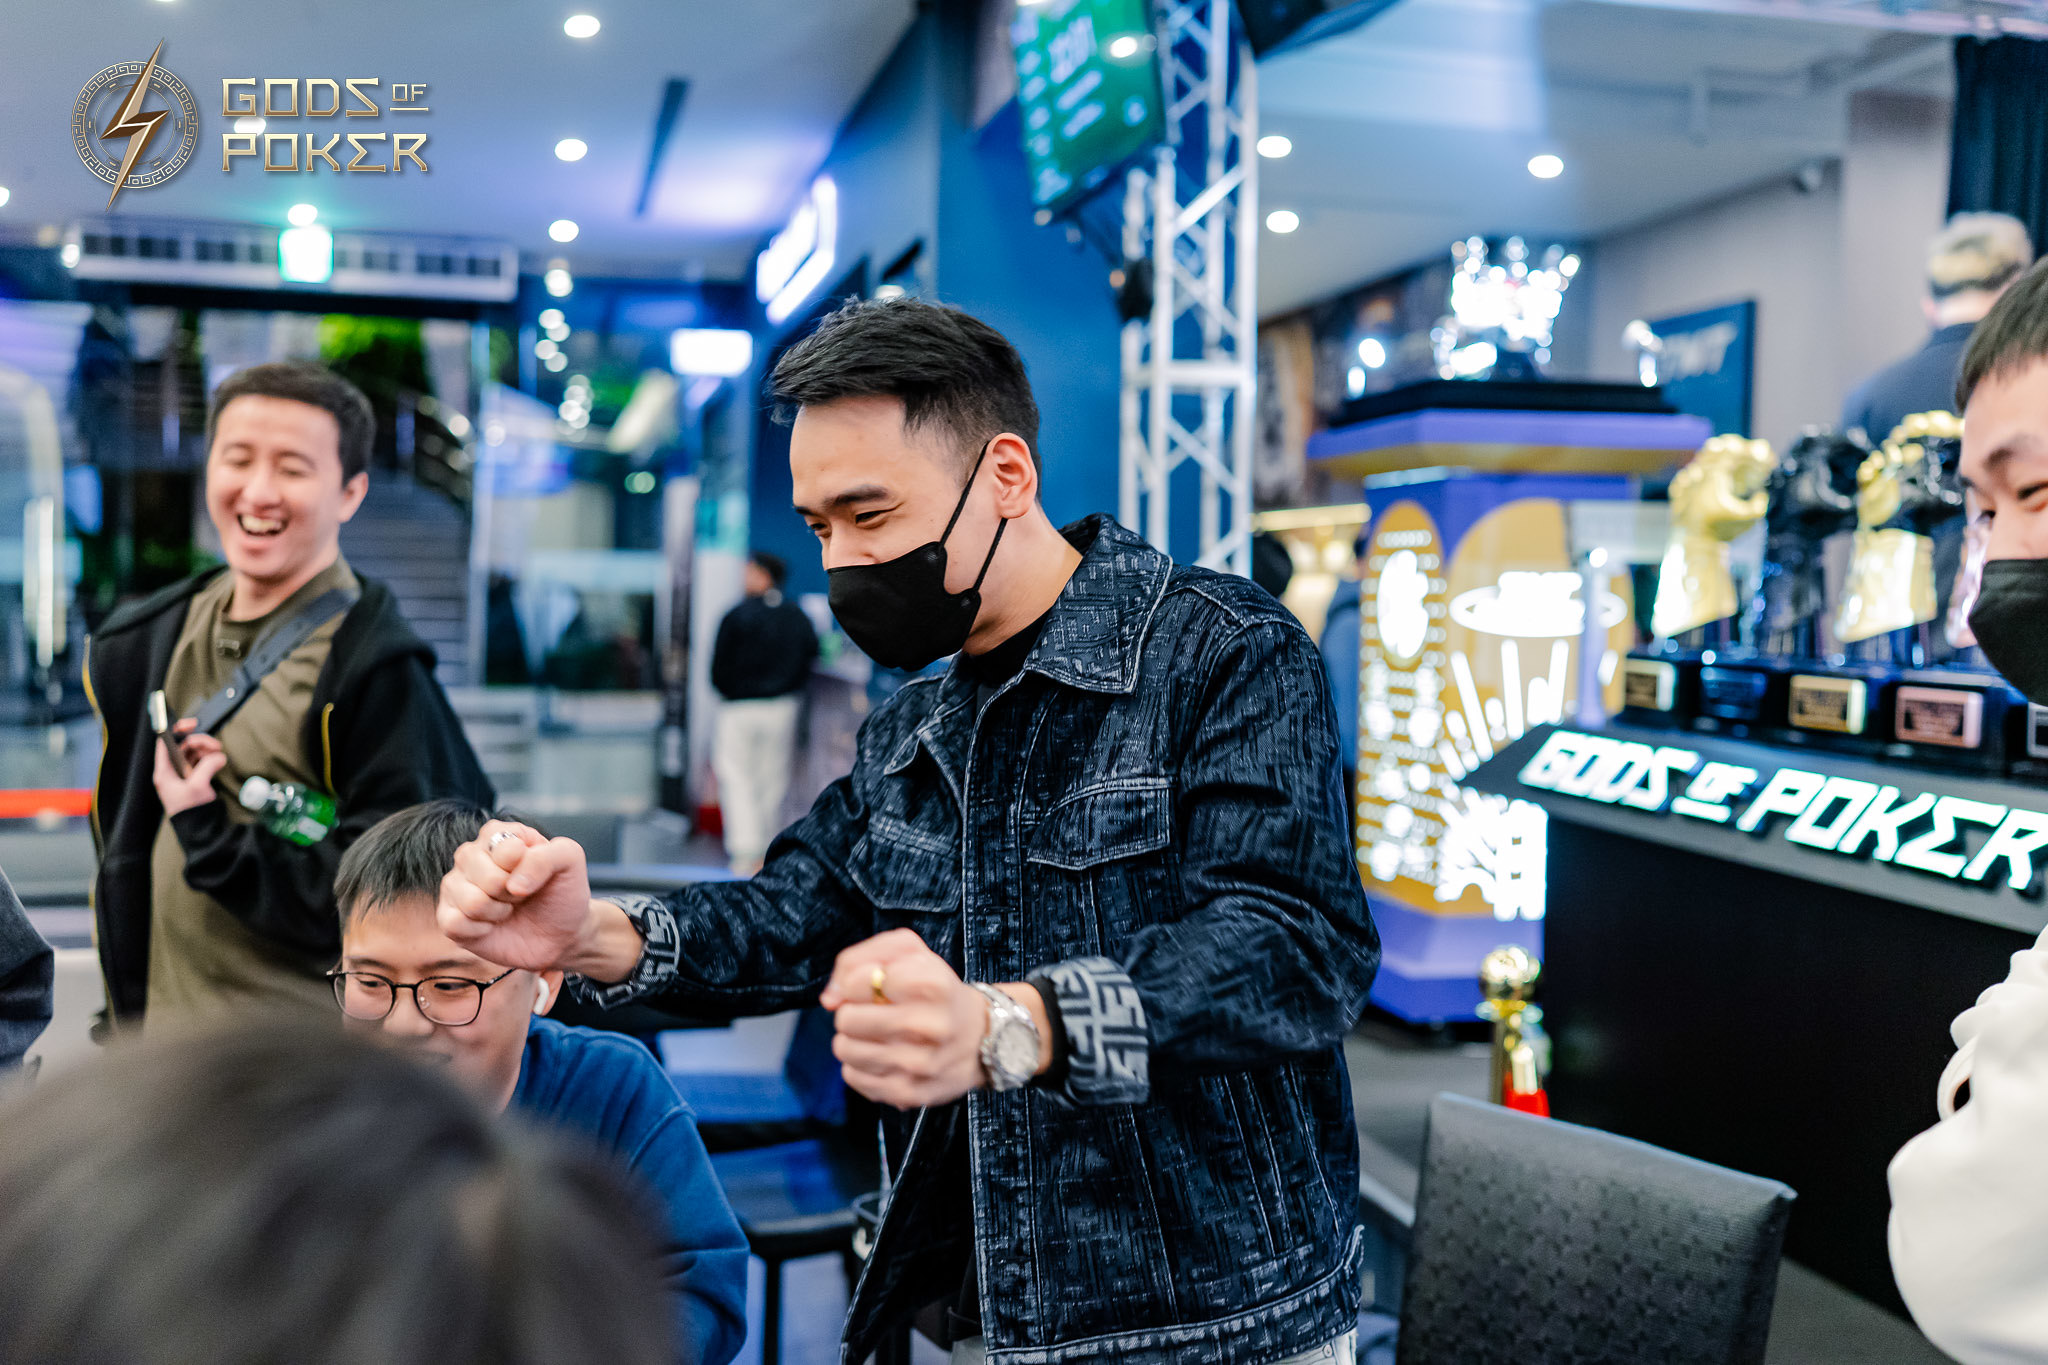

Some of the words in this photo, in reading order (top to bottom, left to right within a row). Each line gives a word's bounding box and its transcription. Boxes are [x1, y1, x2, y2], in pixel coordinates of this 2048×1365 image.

[1518, 730, 1700, 811] GODS
[1684, 761, 1758, 806] OF
[1736, 767, 2048, 889] POKER
